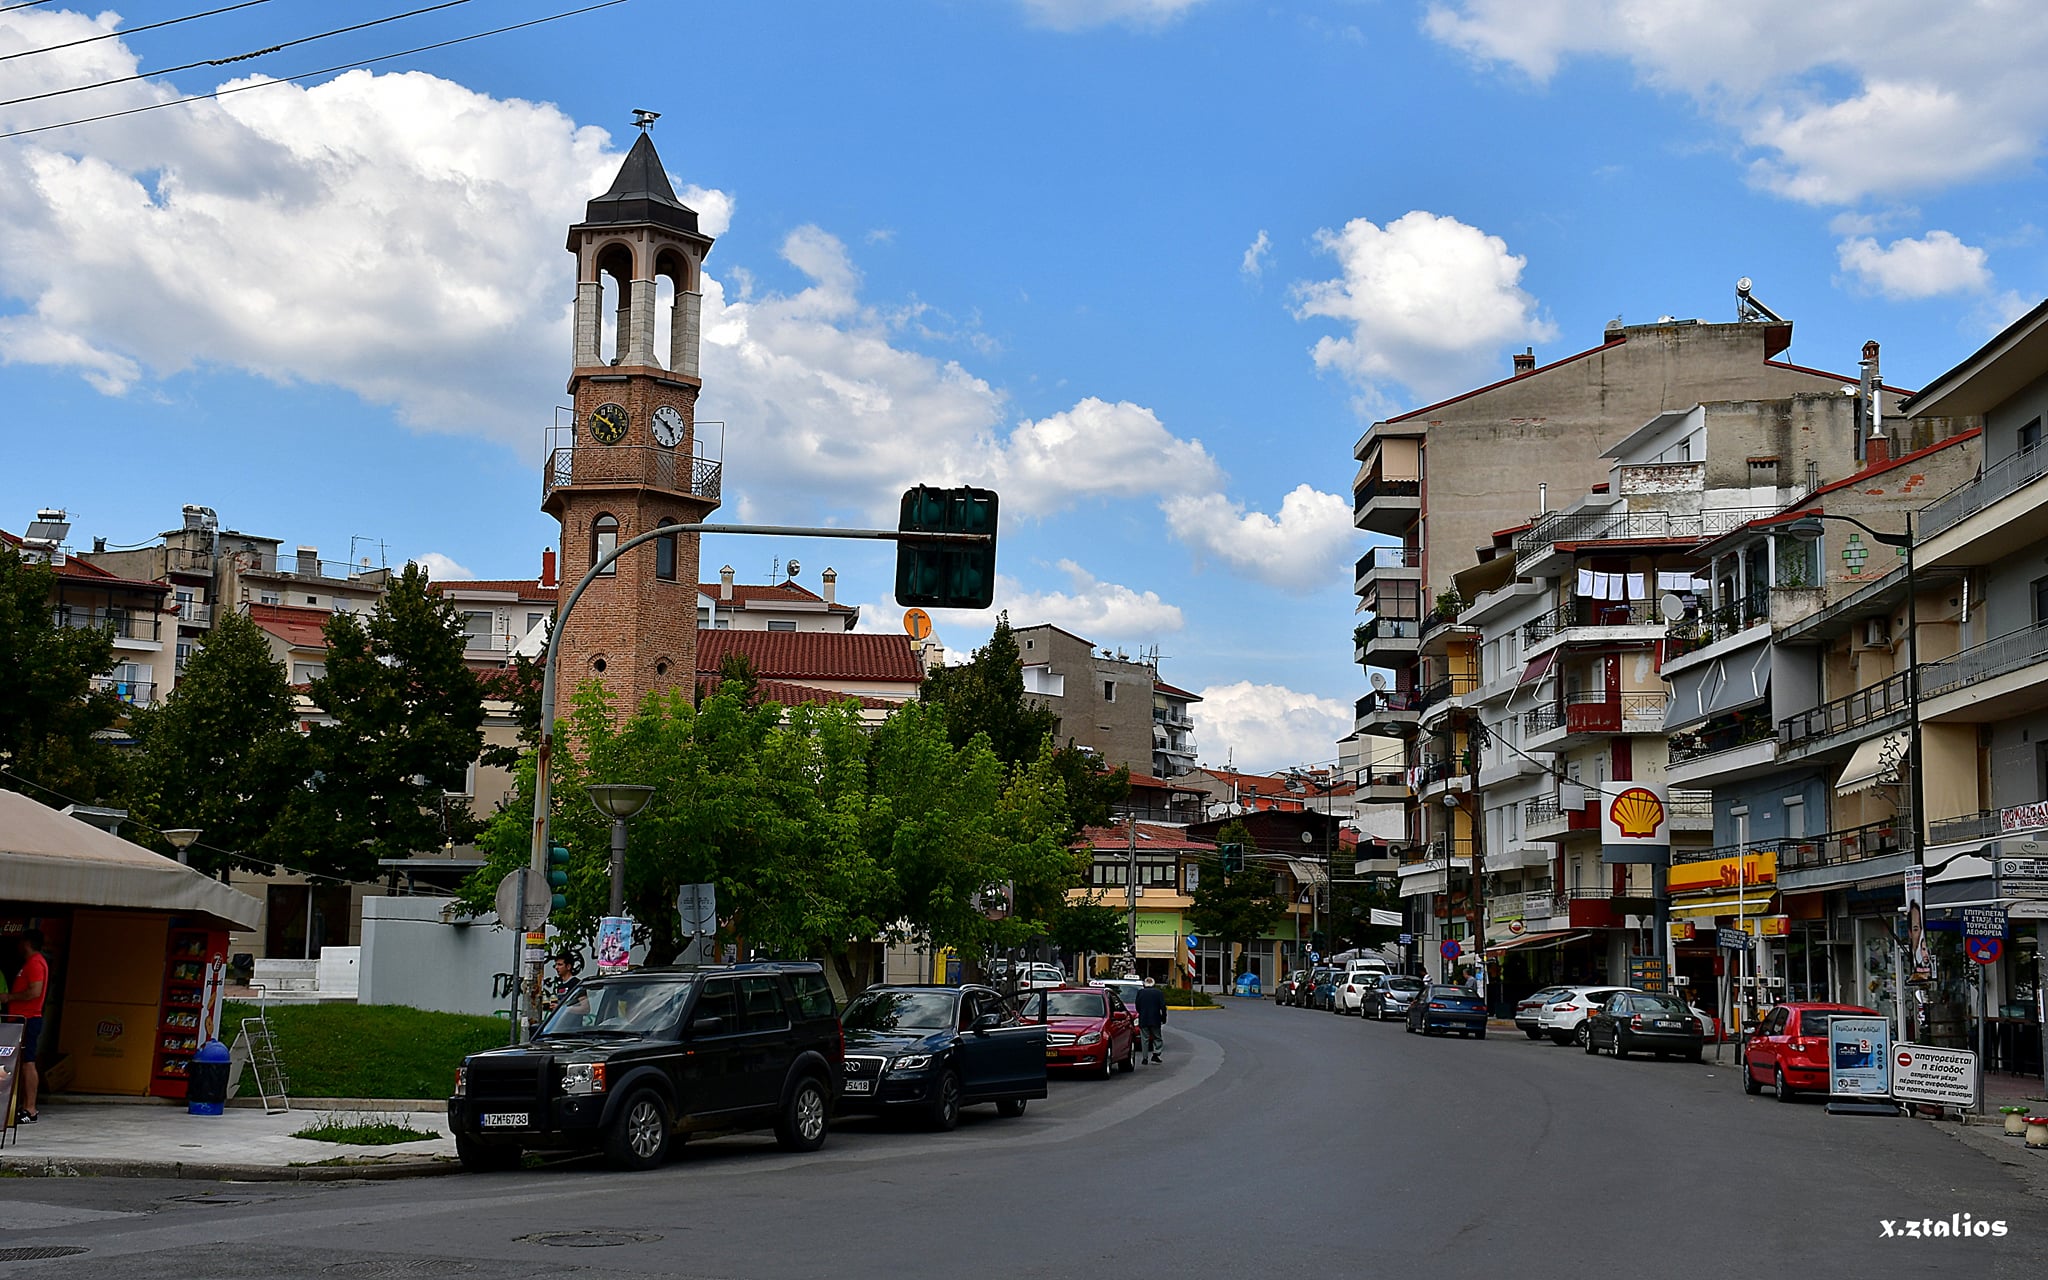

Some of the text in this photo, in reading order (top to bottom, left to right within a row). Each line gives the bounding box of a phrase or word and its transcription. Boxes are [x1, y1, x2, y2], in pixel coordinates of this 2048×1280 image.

[1720, 862, 1754, 886] Shell
[1915, 1052, 1971, 1065] απαγορεύεται
[1930, 1063, 1964, 1075] είσοδος
[1899, 1078, 1968, 1090] πέρατος ανεφοδιασμού
[1906, 1086, 1938, 1095] πρατηρίου
